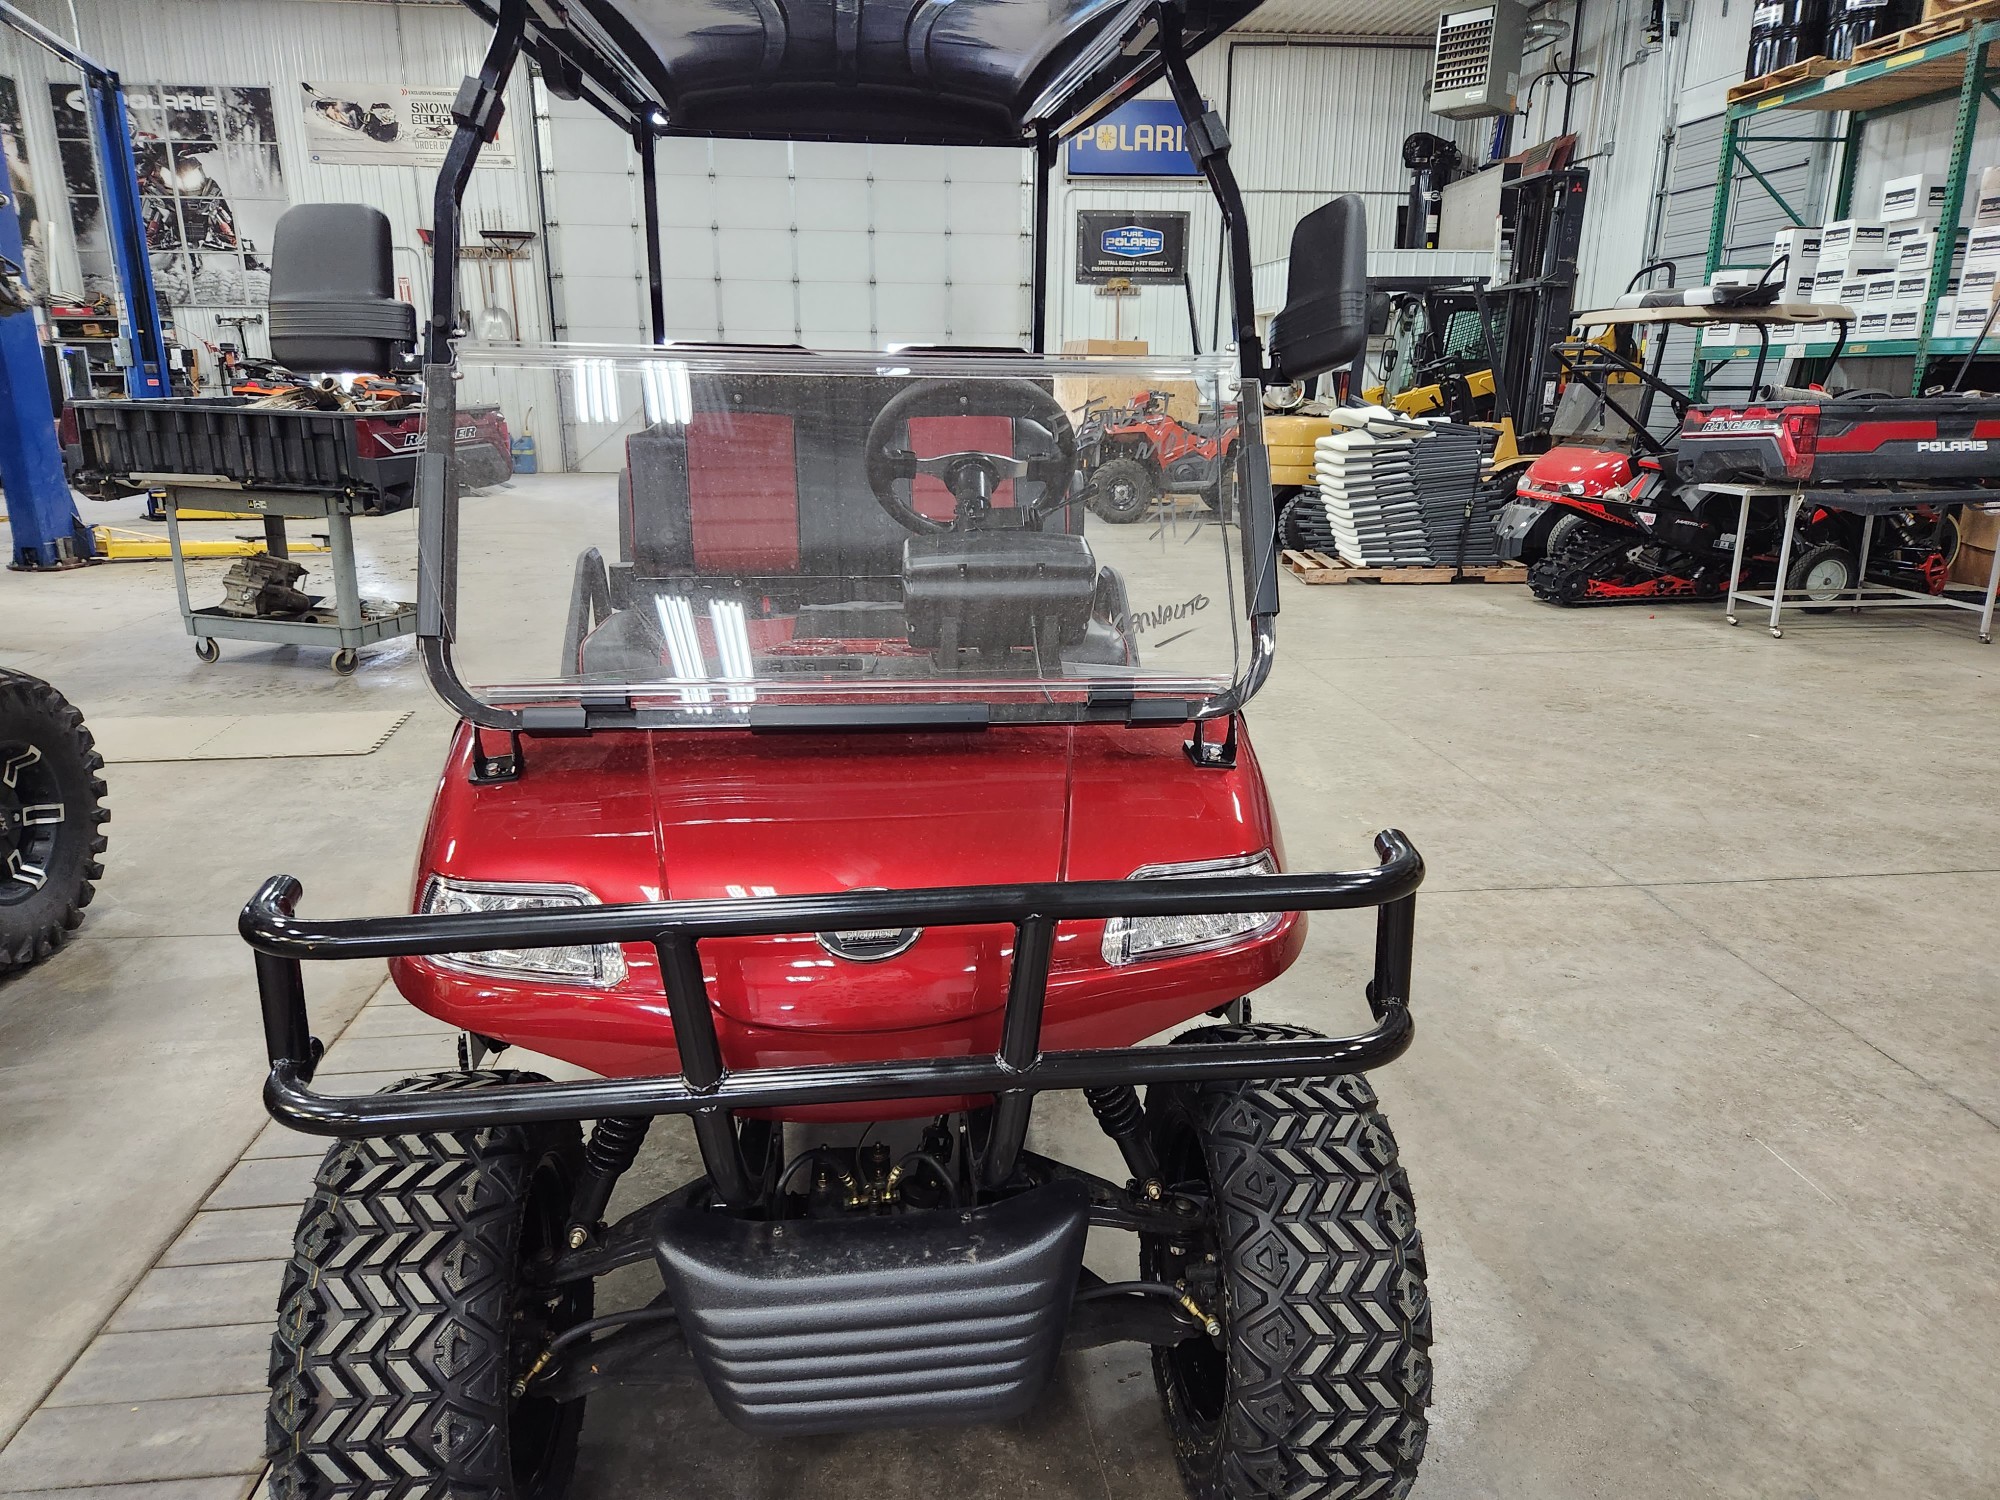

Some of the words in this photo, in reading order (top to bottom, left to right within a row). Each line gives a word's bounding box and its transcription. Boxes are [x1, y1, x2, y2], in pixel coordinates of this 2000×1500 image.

[124, 94, 217, 111] OLARIS
[412, 115, 454, 125] SELECT
[1076, 124, 1189, 152] POLARI
[415, 140, 438, 150] ORDER
[440, 141, 449, 150] BY
[483, 143, 501, 151] 2010
[1885, 193, 1915, 204] POLARIS
[1825, 231, 1850, 241] POLARIS
[1106, 237, 1160, 247] POLARIS
[1902, 247, 1926, 256] POLARIS
[1816, 274, 1843, 283] POLARIS
[1869, 285, 1893, 293] POLARIS
[1898, 282, 1924, 291] POLARIS
[1841, 288, 1865, 296] POLARIS
[1860, 318, 1885, 326] POLARIS
[1891, 317, 1916, 325] POLARIS
[1957, 313, 1986, 321] POLARIS
[1701, 419, 1761, 432] RANGER
[404, 426, 477, 447] RAER
[1917, 440, 1988, 452] POLARIS
